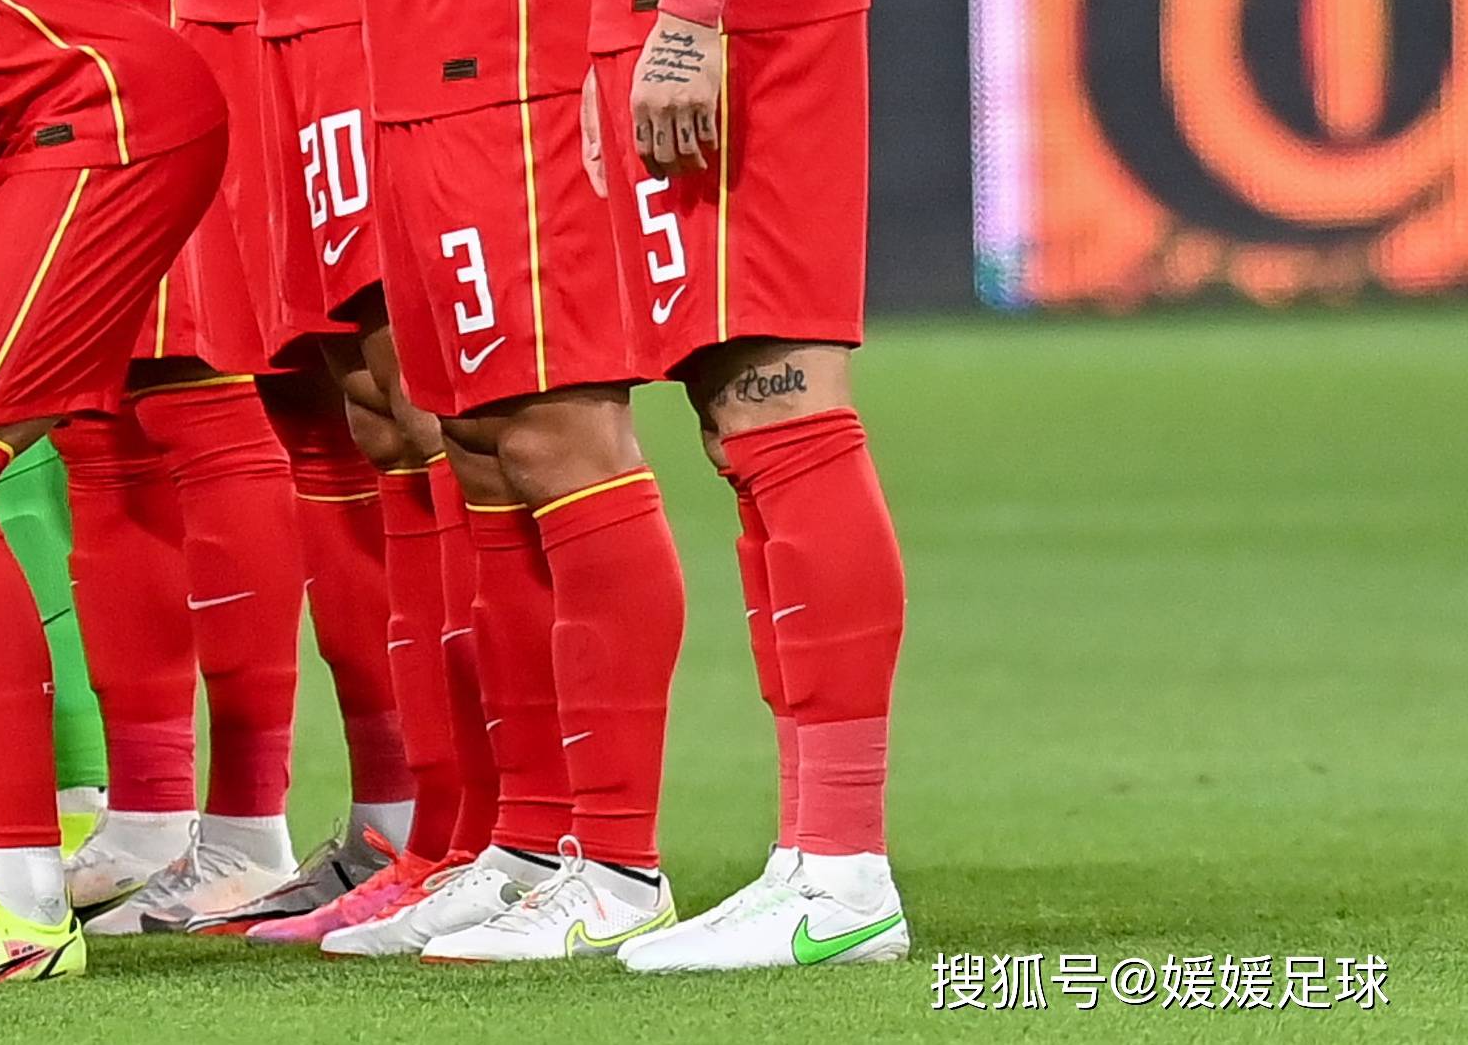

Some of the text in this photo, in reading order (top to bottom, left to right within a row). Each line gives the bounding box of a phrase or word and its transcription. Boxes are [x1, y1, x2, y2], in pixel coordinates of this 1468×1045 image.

[298, 109, 370, 230] 20
[440, 226, 495, 334] 3
[634, 175, 687, 284] 5
